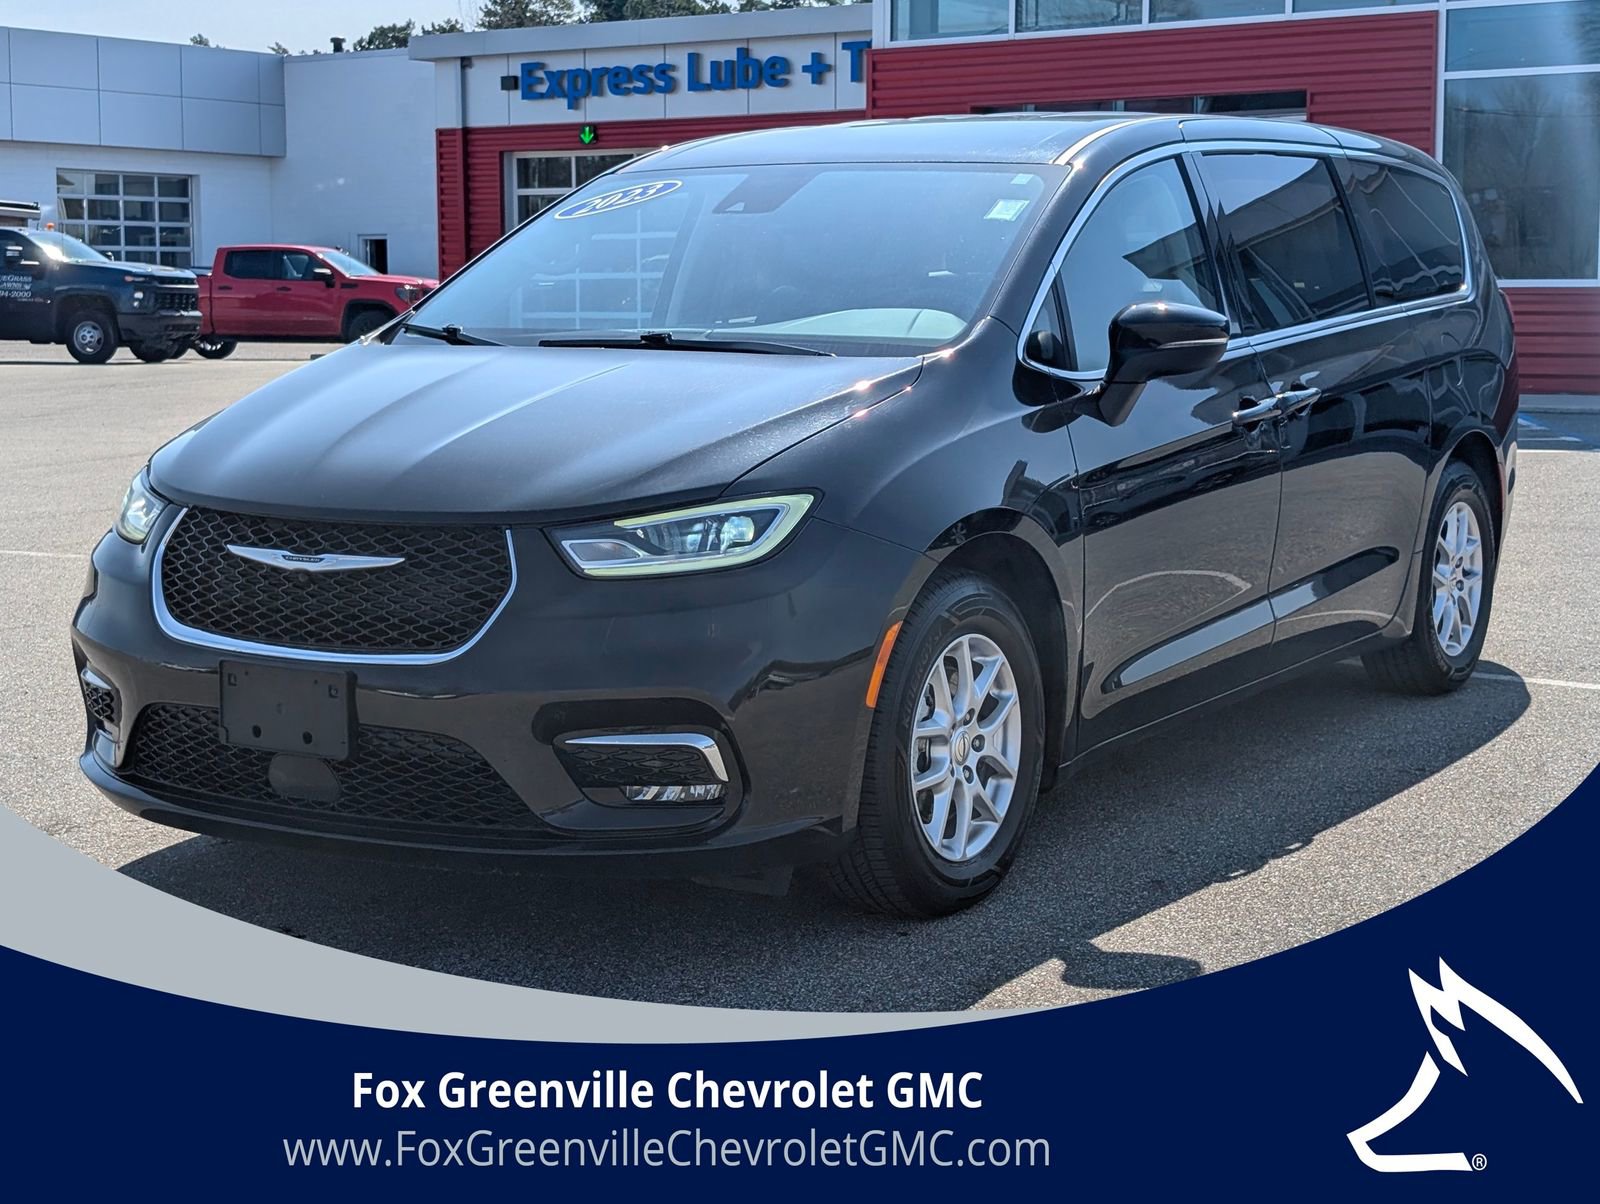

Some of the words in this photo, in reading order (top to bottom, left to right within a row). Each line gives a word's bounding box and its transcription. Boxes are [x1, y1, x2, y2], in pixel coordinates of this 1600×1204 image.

[520, 62, 677, 110] Express
[687, 47, 791, 93] Lube
[841, 39, 872, 83] T
[572, 183, 665, 216] 2023
